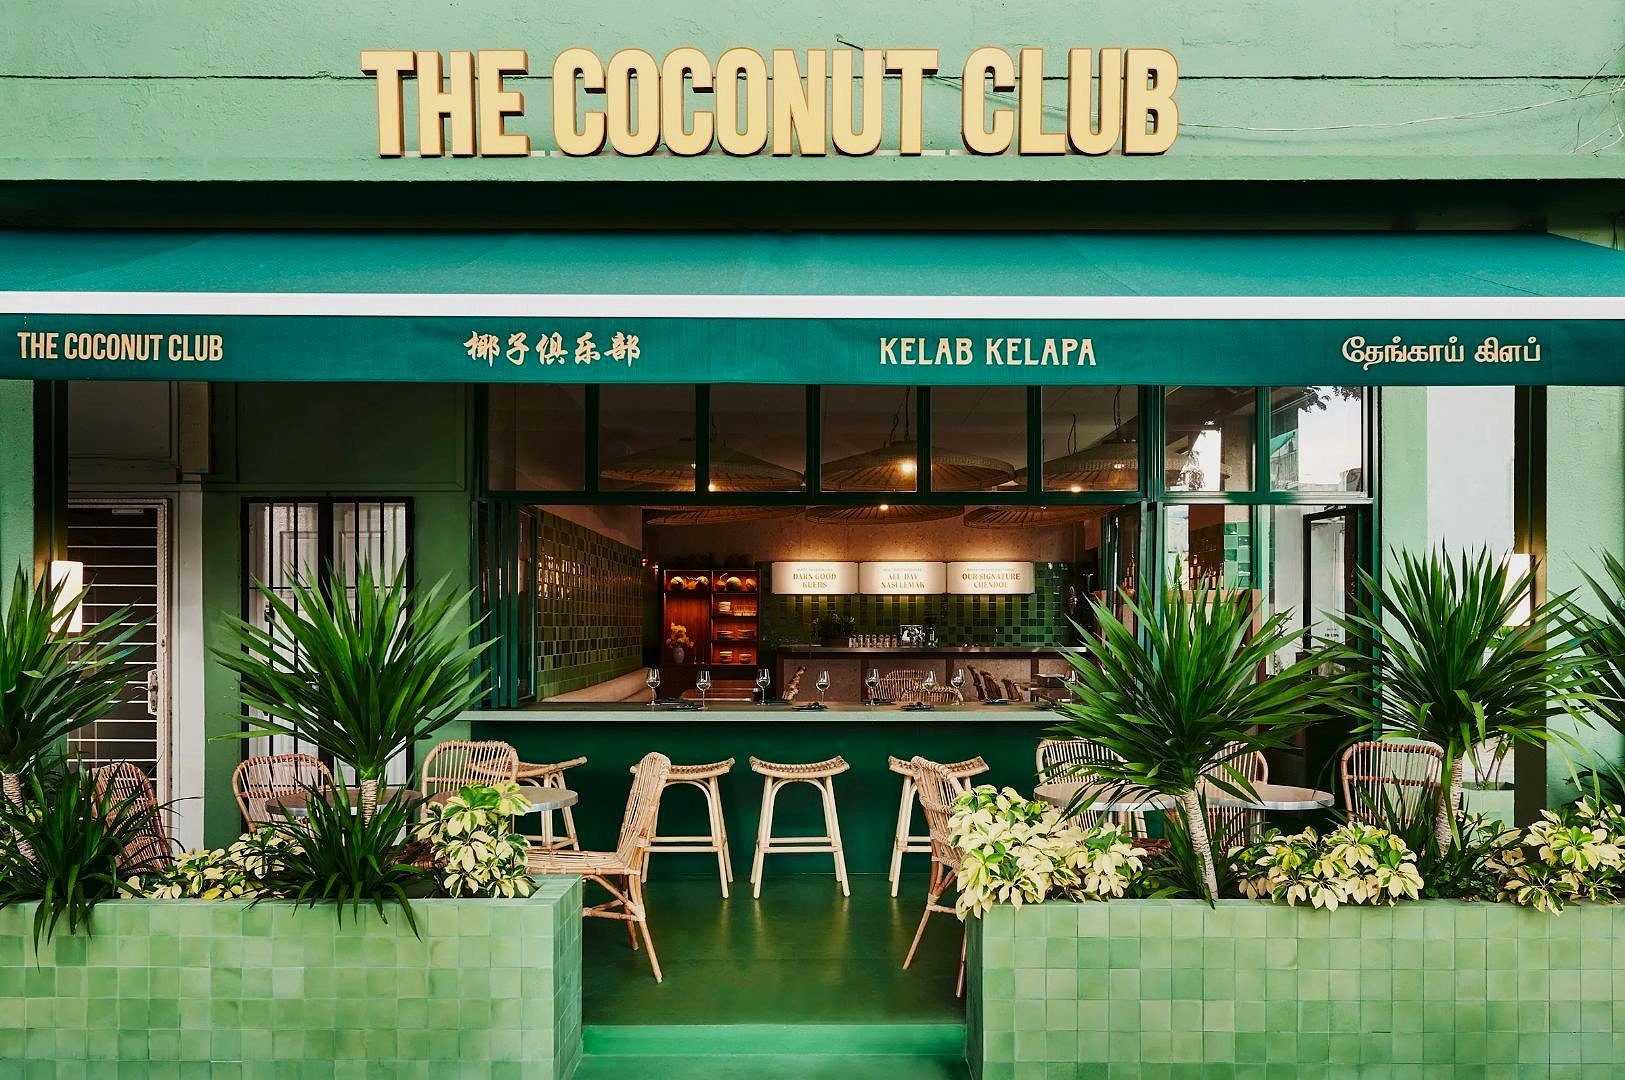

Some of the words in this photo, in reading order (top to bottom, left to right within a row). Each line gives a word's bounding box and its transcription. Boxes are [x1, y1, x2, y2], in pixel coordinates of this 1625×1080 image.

[360, 49, 529, 158] THE
[552, 47, 939, 156] COCONUT
[962, 46, 1180, 156] CLUB
[17, 332, 59, 359] THE
[64, 333, 163, 361] COCONUT
[168, 334, 223, 361] CLUB
[463, 331, 641, 368] 椰子俱乐部
[879, 337, 973, 365] KELAB
[985, 338, 1097, 366] KELAPA
[1342, 336, 1465, 371] தேங்காய்
[1474, 336, 1541, 363] கிளப்
[973, 581, 1009, 589] CHENDOL
